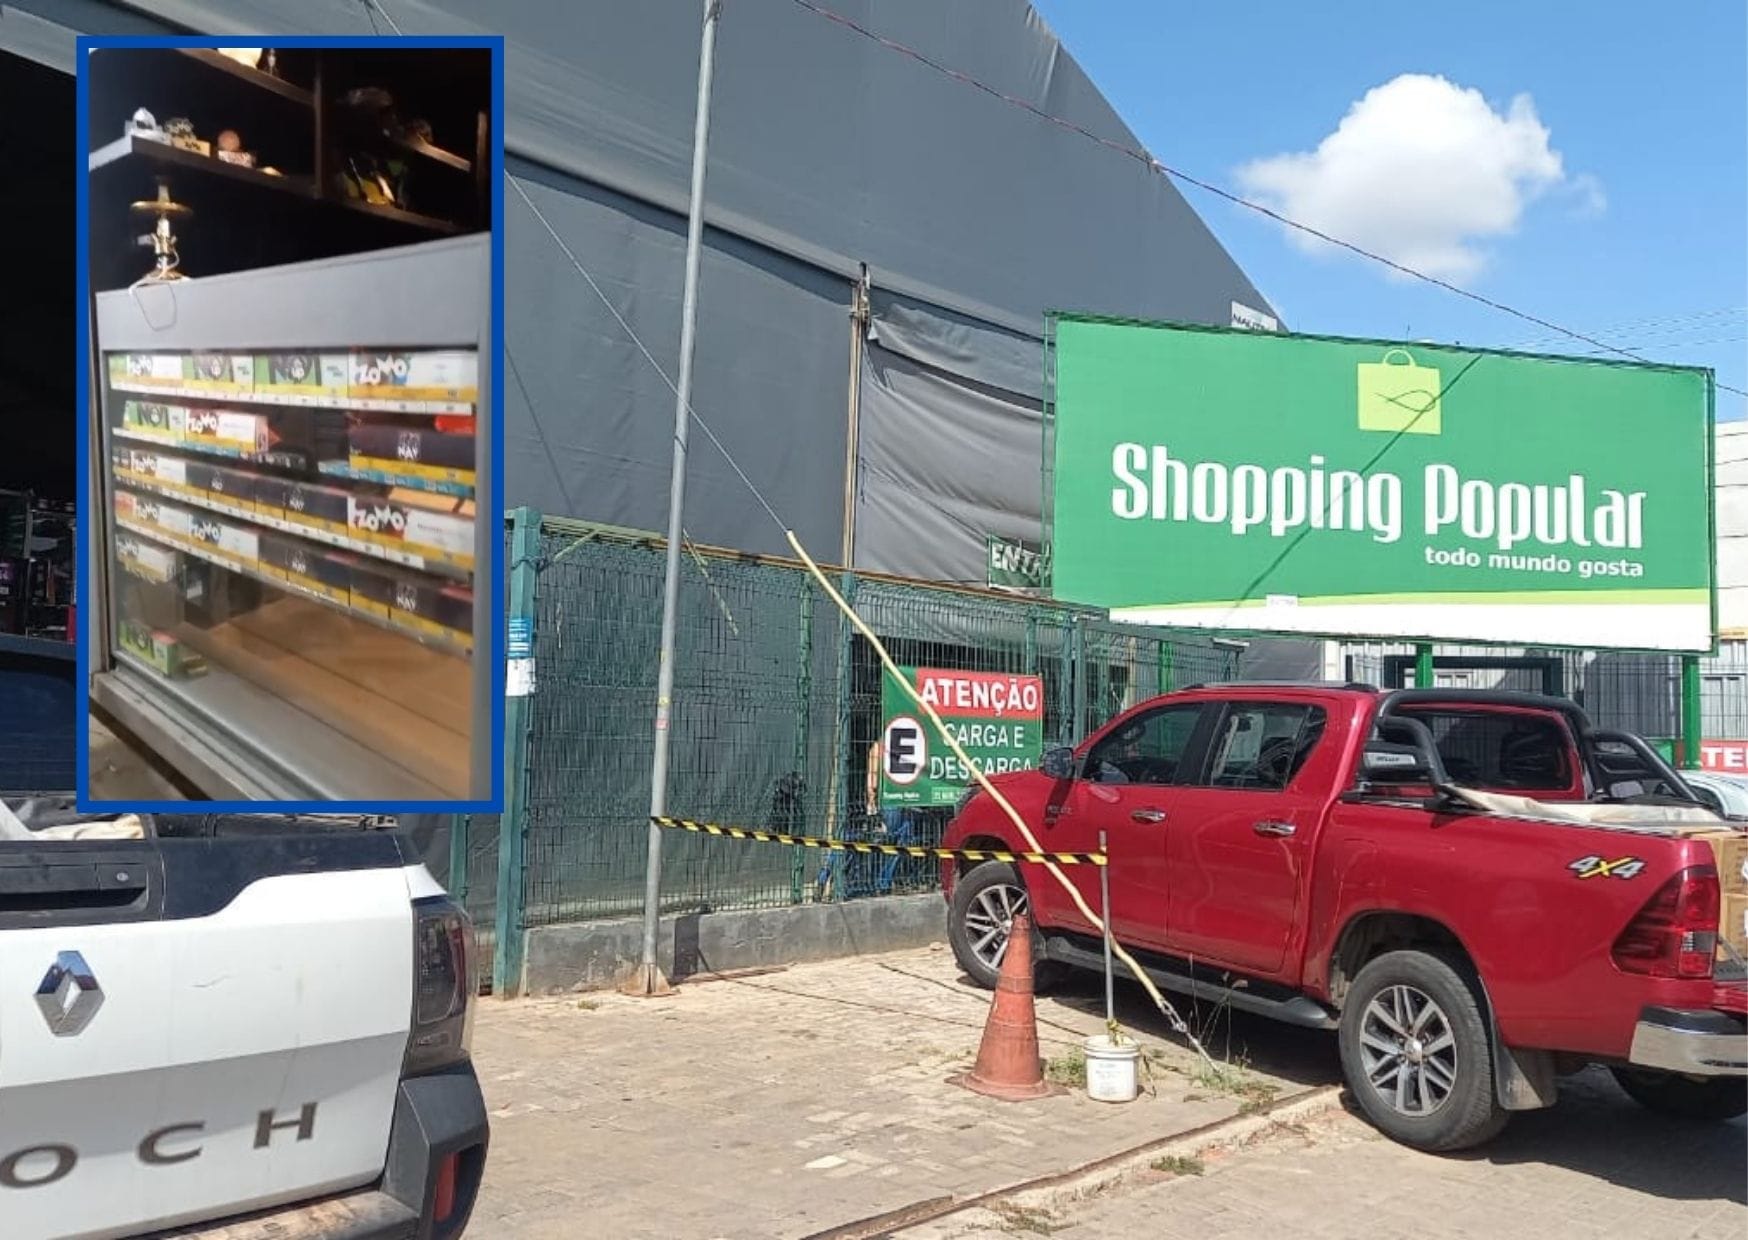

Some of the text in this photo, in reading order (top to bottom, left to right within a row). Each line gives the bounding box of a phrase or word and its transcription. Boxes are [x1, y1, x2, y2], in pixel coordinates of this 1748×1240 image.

[1111, 442, 1648, 551] Shopping Popular
[1424, 546, 1645, 579] todo mundo gosta
[920, 678, 1038, 717] ATENÇÃO
[889, 727, 917, 774] E
[1013, 726, 1025, 748] E
